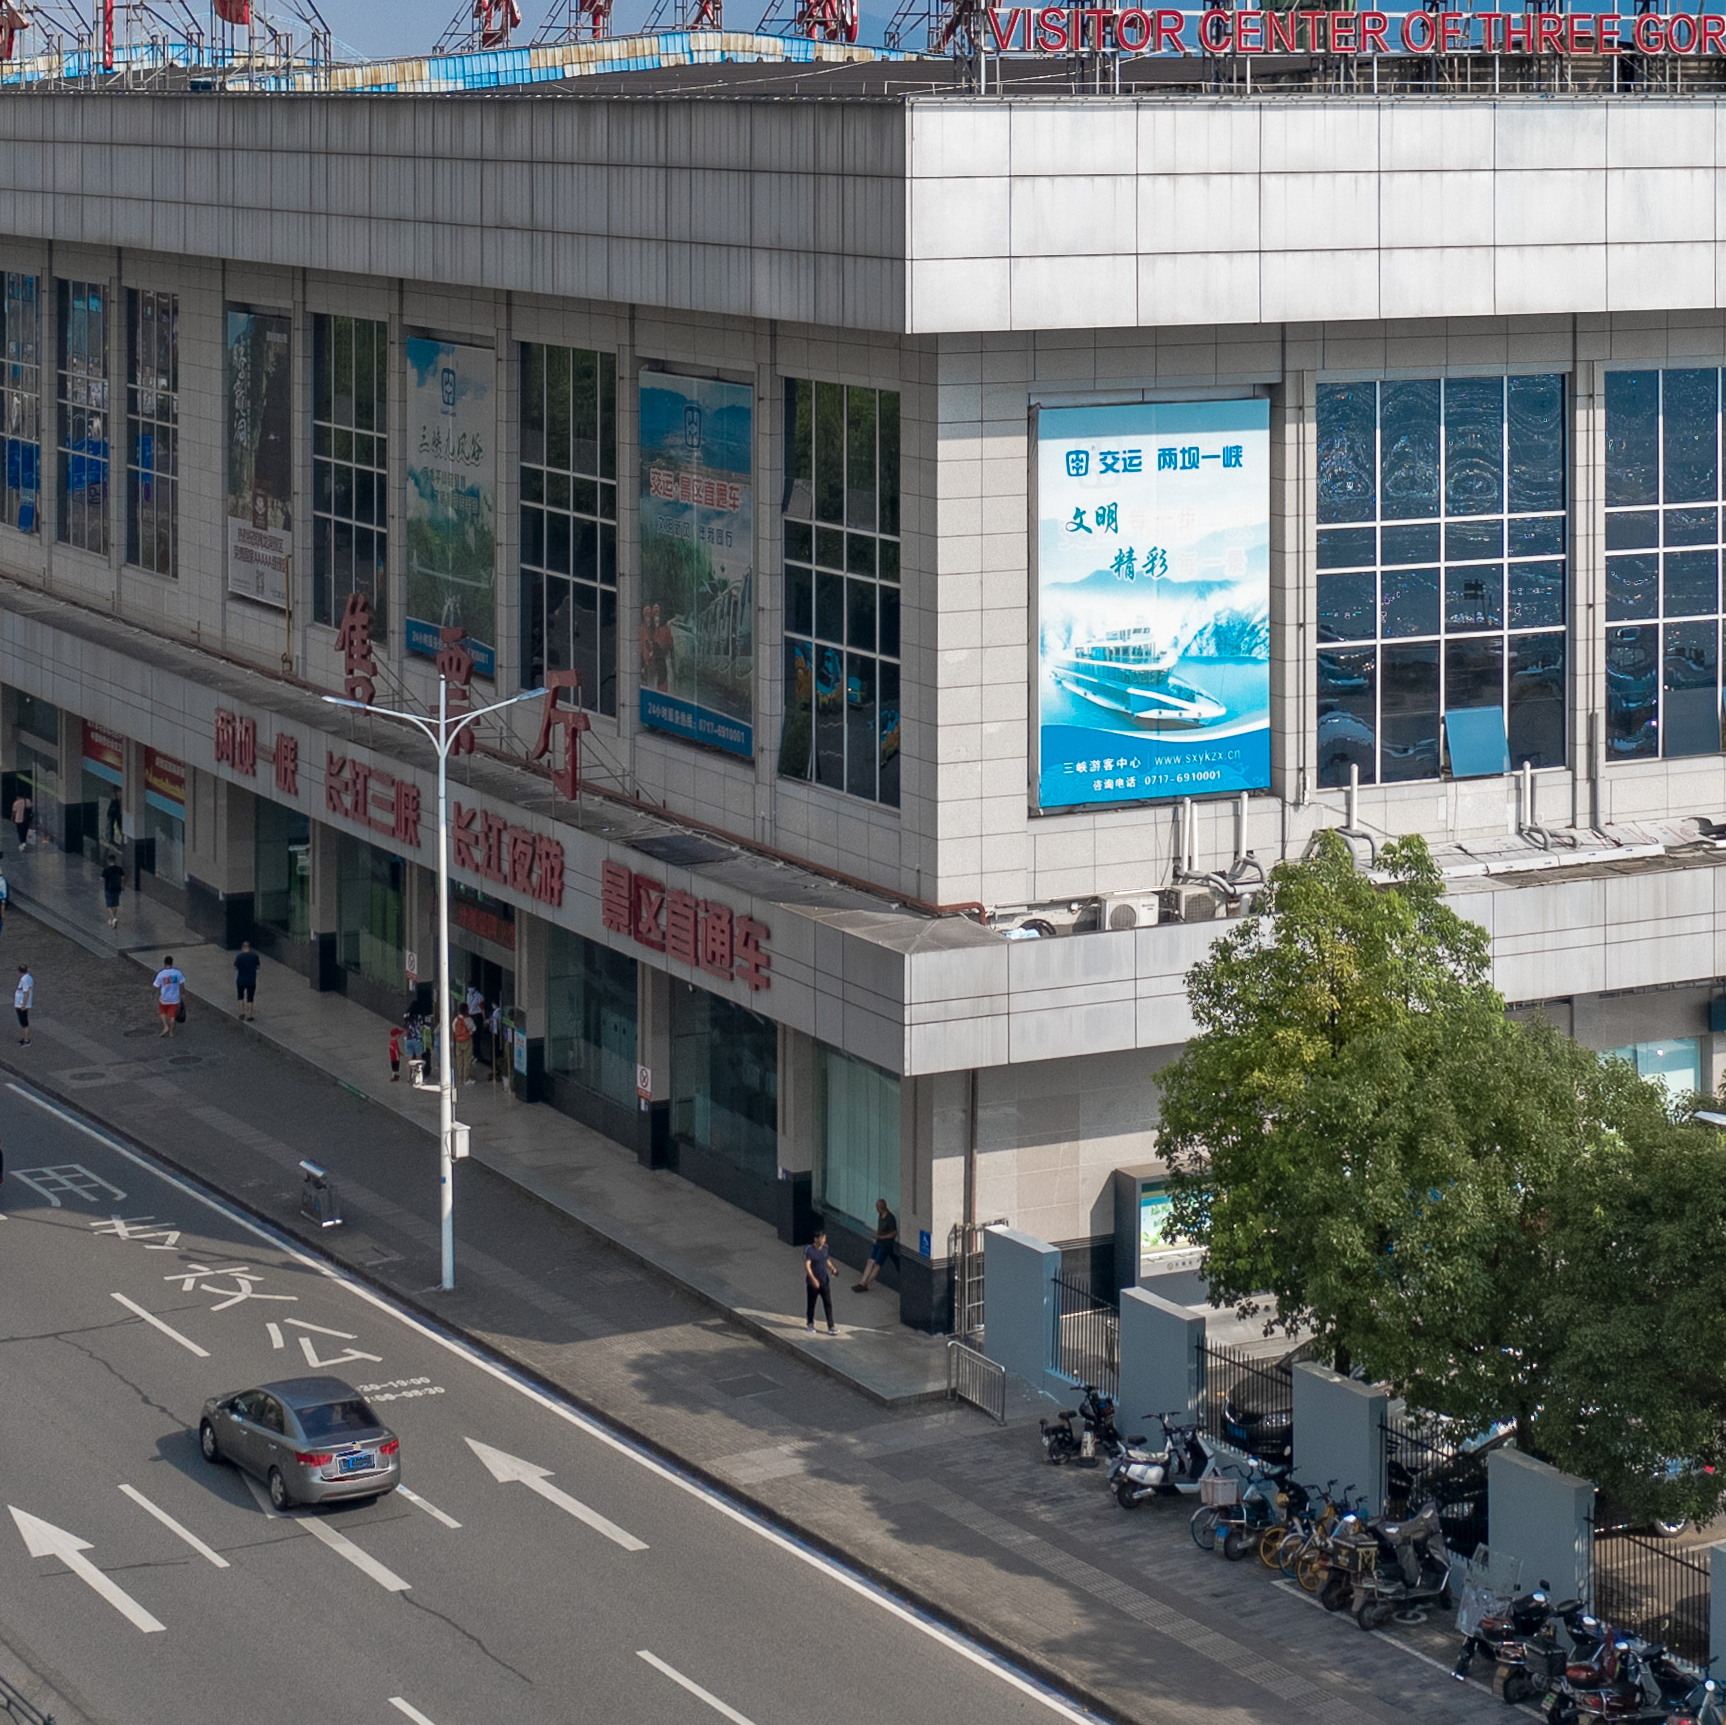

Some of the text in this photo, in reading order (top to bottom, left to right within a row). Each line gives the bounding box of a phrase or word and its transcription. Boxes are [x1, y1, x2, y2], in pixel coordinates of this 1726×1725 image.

[987, 7, 1186, 53] VISITOR
[1199, 9, 1390, 54] CENTER
[1402, 10, 1463, 54] OF
[1477, 12, 1621, 55] THREE
[1098, 445, 1243, 474] 交运 两坝一峡
[1066, 502, 1119, 534] 文明
[1109, 546, 1169, 581] 精彩
[334, 593, 591, 800] 售票厅
[214, 706, 298, 797] 两坝一峡
[1062, 757, 1142, 774] 三峡游客中心
[325, 750, 421, 848] 长江三峡
[452, 800, 565, 907] 长江夜游
[601, 859, 772, 992] 景区直通车
